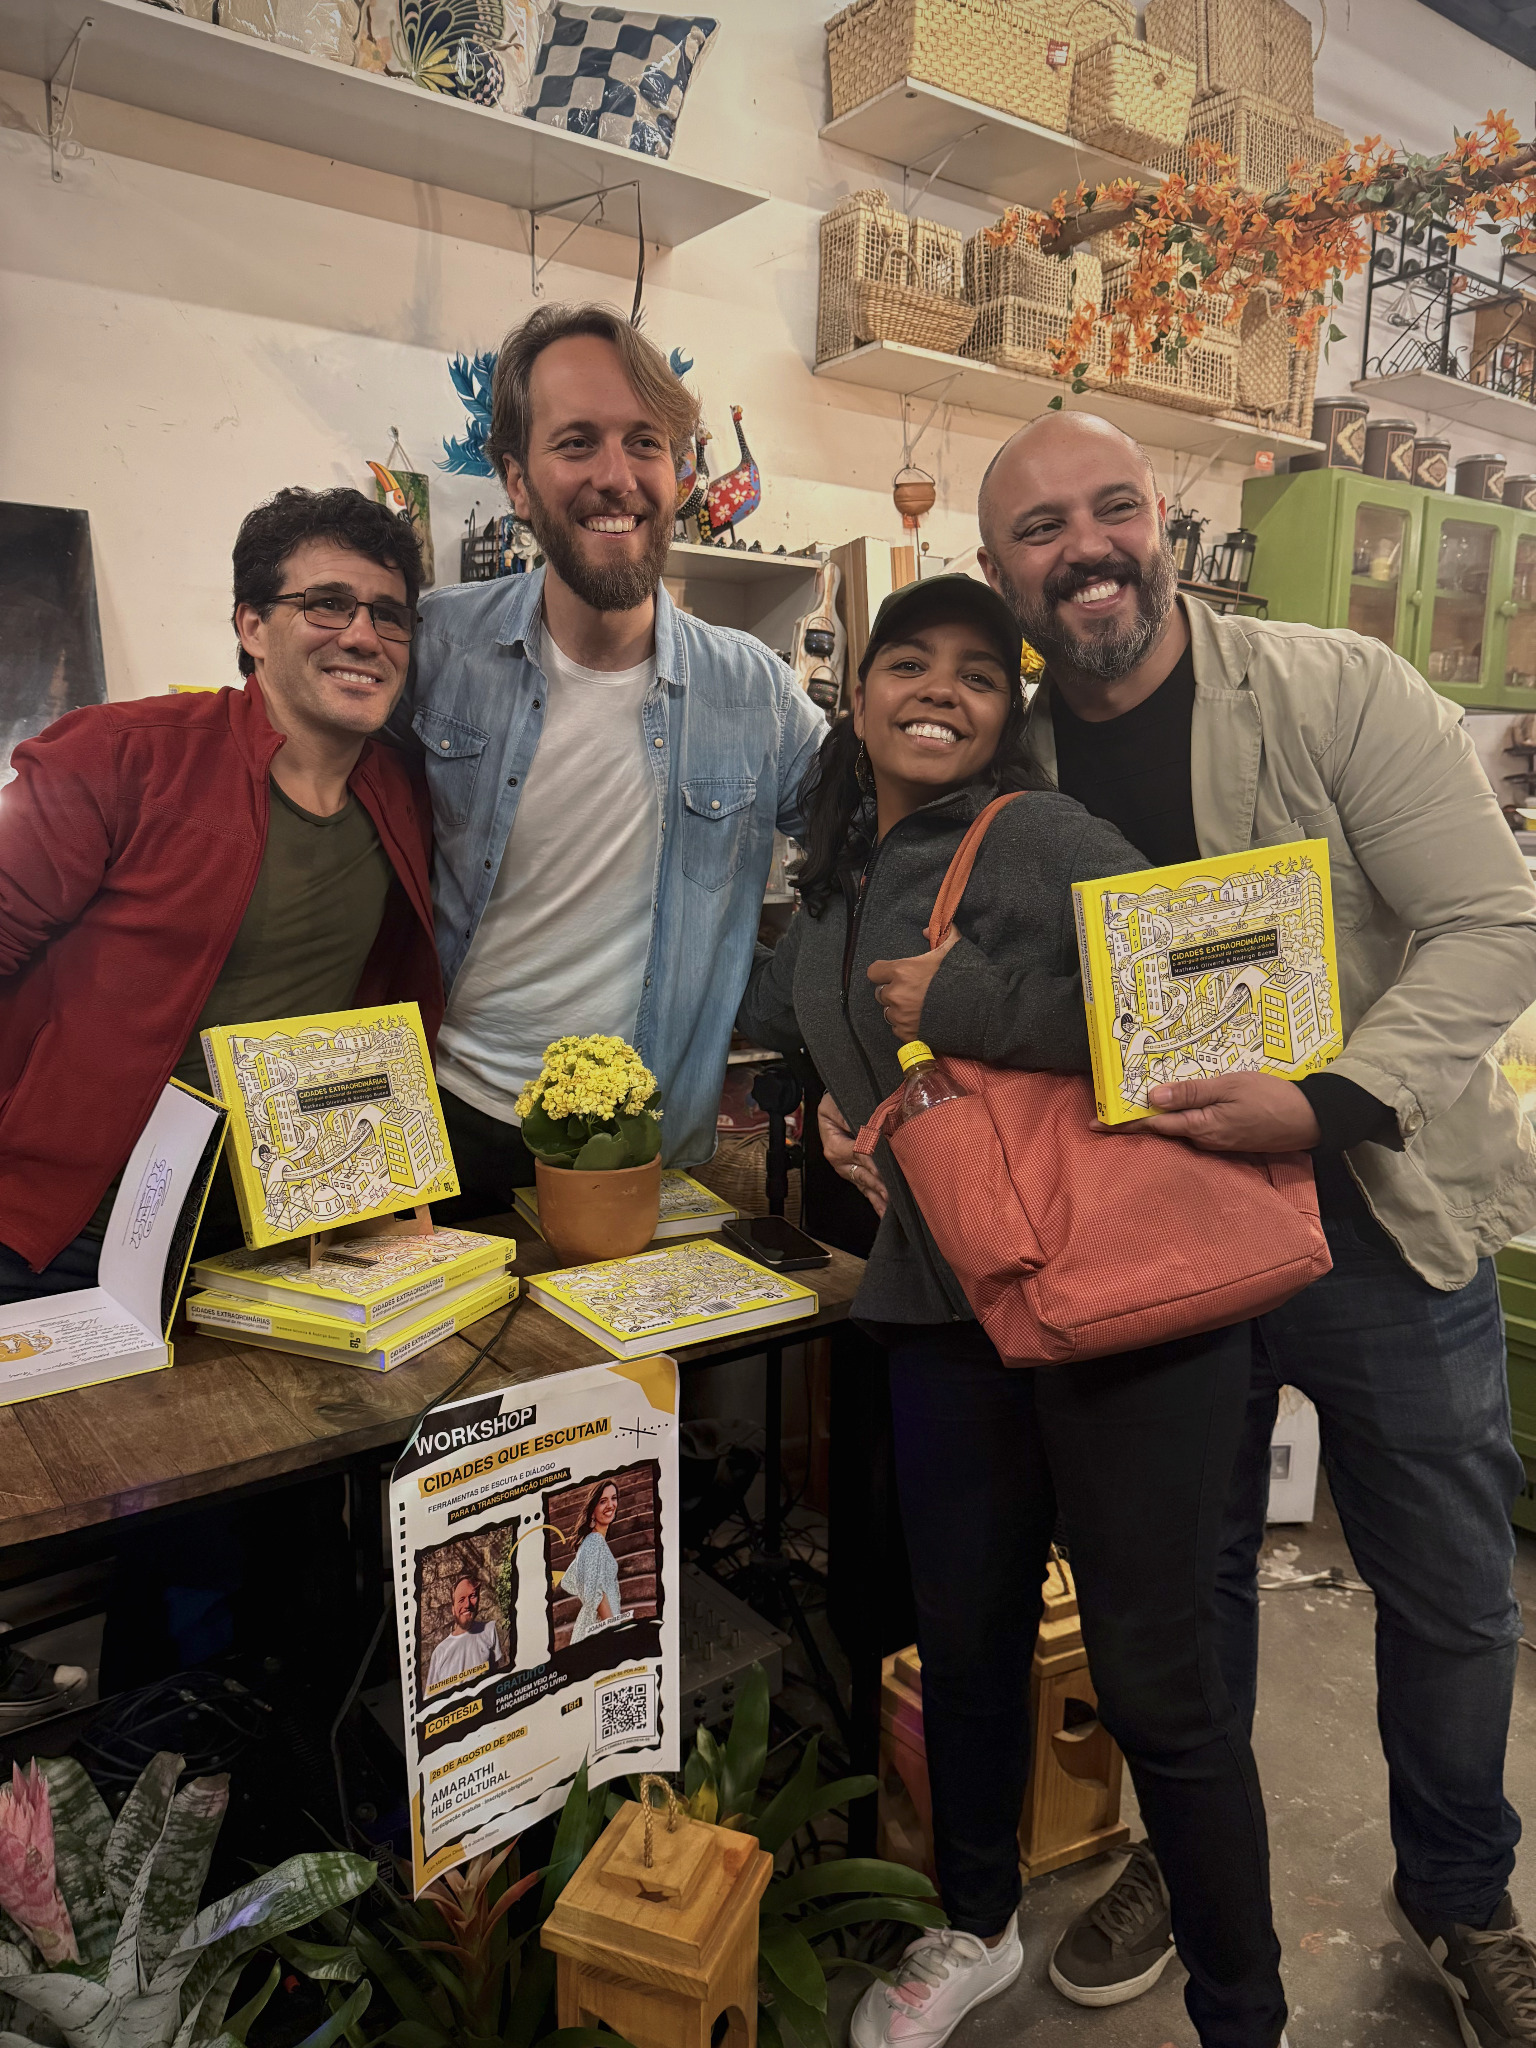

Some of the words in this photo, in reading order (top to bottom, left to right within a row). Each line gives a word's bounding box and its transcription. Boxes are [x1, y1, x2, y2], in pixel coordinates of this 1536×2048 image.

[415, 1408, 532, 1456] WORKSHOP
[424, 1455, 493, 1493] CIDADES
[498, 1442, 530, 1464] QUE
[535, 1419, 608, 1451] ESCUTAM
[428, 1489, 479, 1513] FERRAMENTAS
[480, 1486, 490, 1494] DE
[491, 1475, 518, 1490] ESCUTA
[526, 1462, 555, 1477] DIÁLOGO
[451, 1508, 469, 1521] PARA
[471, 1505, 477, 1513] A
[478, 1481, 539, 1508] TRANSFORMAÇÃO
[540, 1471, 568, 1486] URBANA
[587, 1622, 606, 1633] JOANA
[607, 1612, 631, 1625] RIBEIRO
[429, 1675, 458, 1692] MATHEUS
[459, 1664, 487, 1679] OLIVEIRA
[496, 1664, 546, 1694] GRATUITO
[496, 1693, 513, 1705] PARA
[514, 1684, 533, 1697] QUEM
[533, 1677, 547, 1688] VEIO
[548, 1671, 558, 1682] AO
[496, 1690, 538, 1713] LANÇAMENTO
[539, 1685, 549, 1694] DO
[550, 1675, 568, 1689] LIVRO
[428, 1702, 479, 1734] CORTESIA
[564, 1699, 580, 1713] 16H
[432, 1769, 441, 1780] 26
[442, 1761, 455, 1772] DE
[457, 1744, 492, 1765] AGOSTO
[493, 1737, 505, 1748] DE
[506, 1728, 525, 1742] 2026
[431, 1762, 494, 1807] AMARATHI
[431, 1800, 453, 1819] HUB
[455, 1770, 511, 1804] CULTURAL
[431, 1812, 461, 1834] Participação
